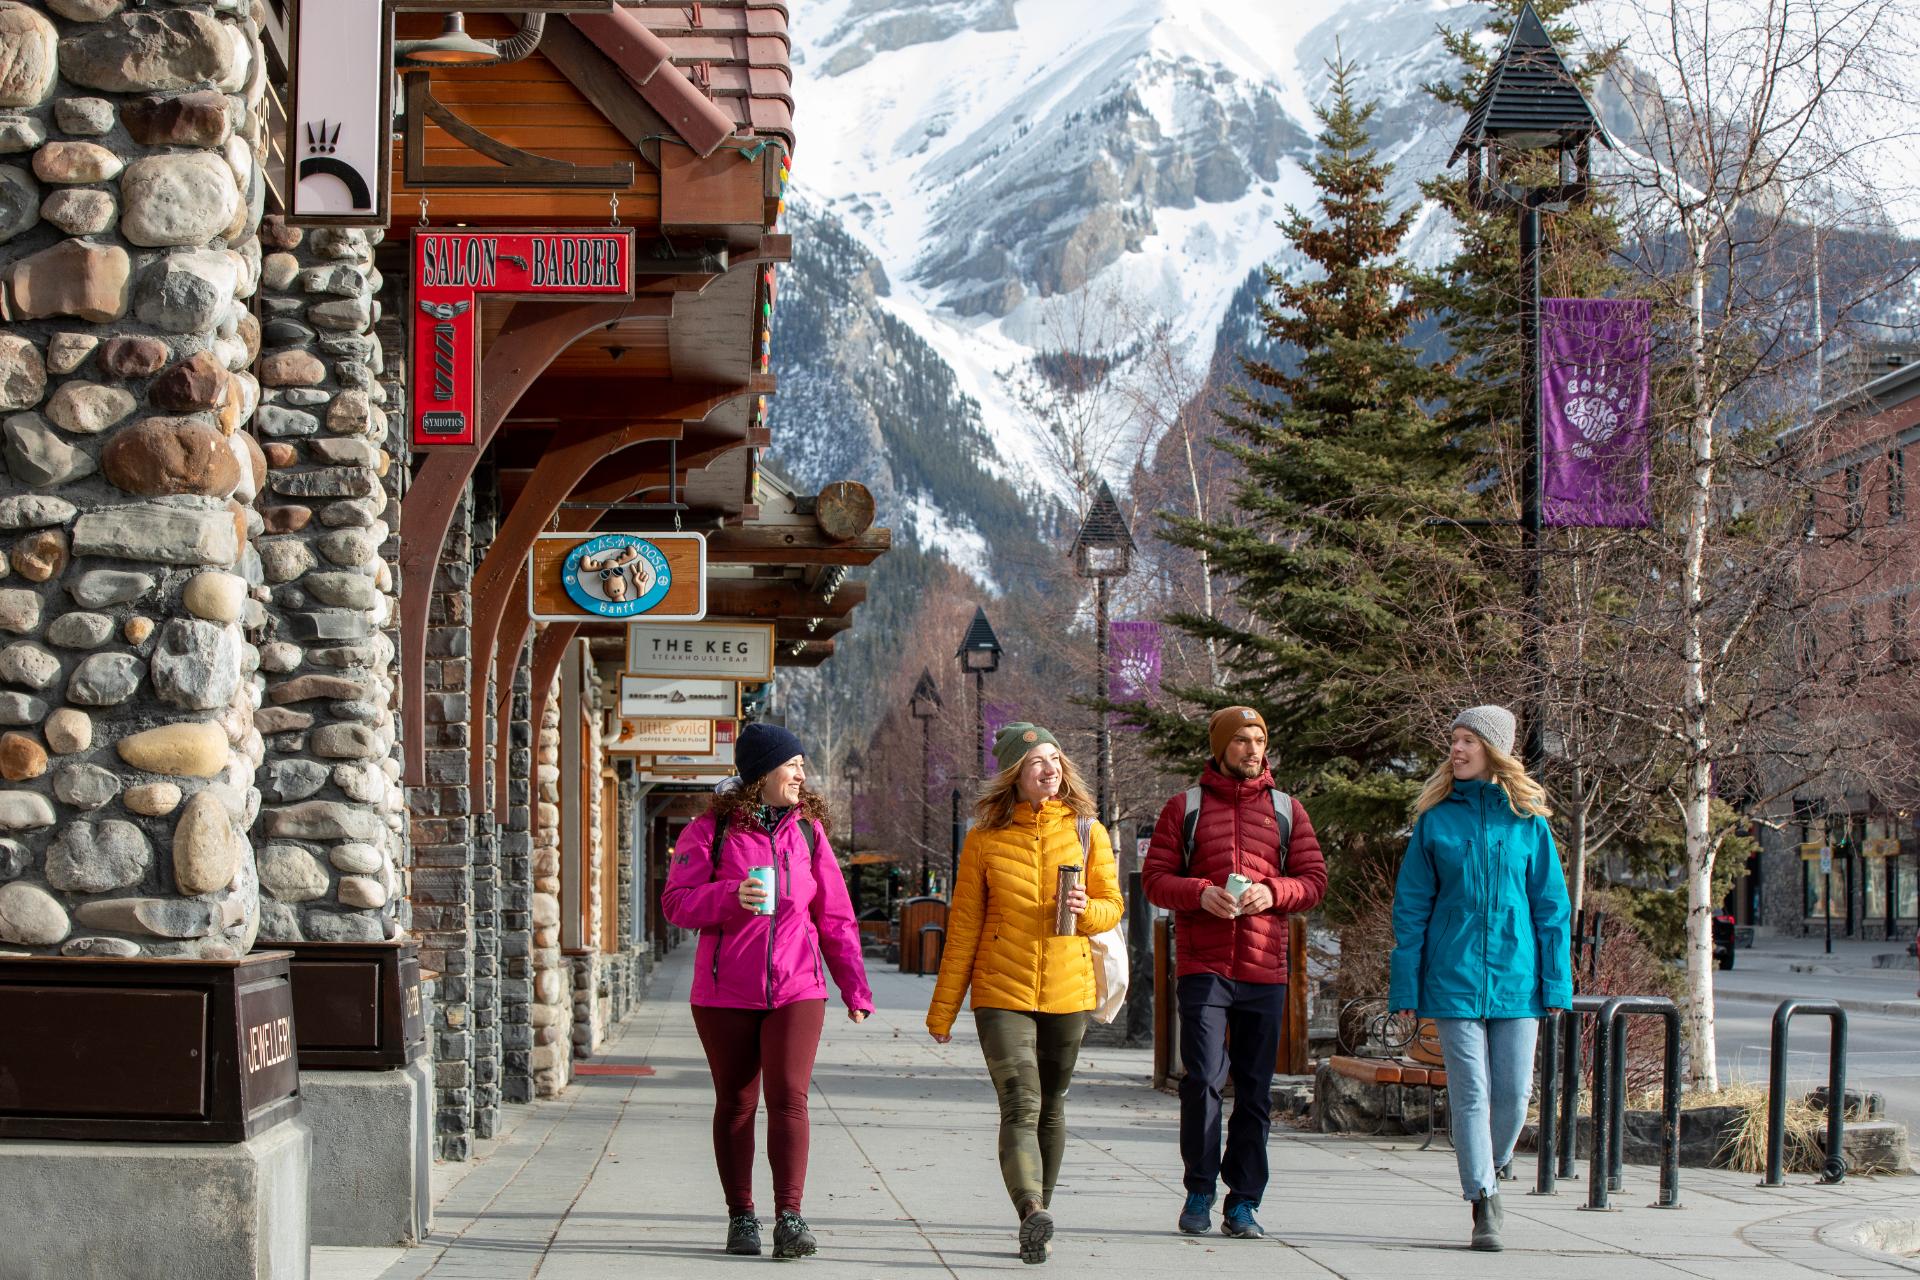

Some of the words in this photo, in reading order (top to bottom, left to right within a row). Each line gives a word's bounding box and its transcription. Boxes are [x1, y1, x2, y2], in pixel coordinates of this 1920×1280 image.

[424, 237, 497, 287] SALON
[531, 238, 620, 287] BARBER
[424, 417, 464, 427] SYMIOTICS
[631, 540, 667, 572] MOOSE
[652, 638, 693, 653] THE
[706, 641, 748, 654] KEG
[652, 654, 719, 662] STEAKHOUSE
[639, 720, 672, 735] little
[676, 720, 707, 735] wild
[248, 1016, 292, 1074] JEWELLERY
